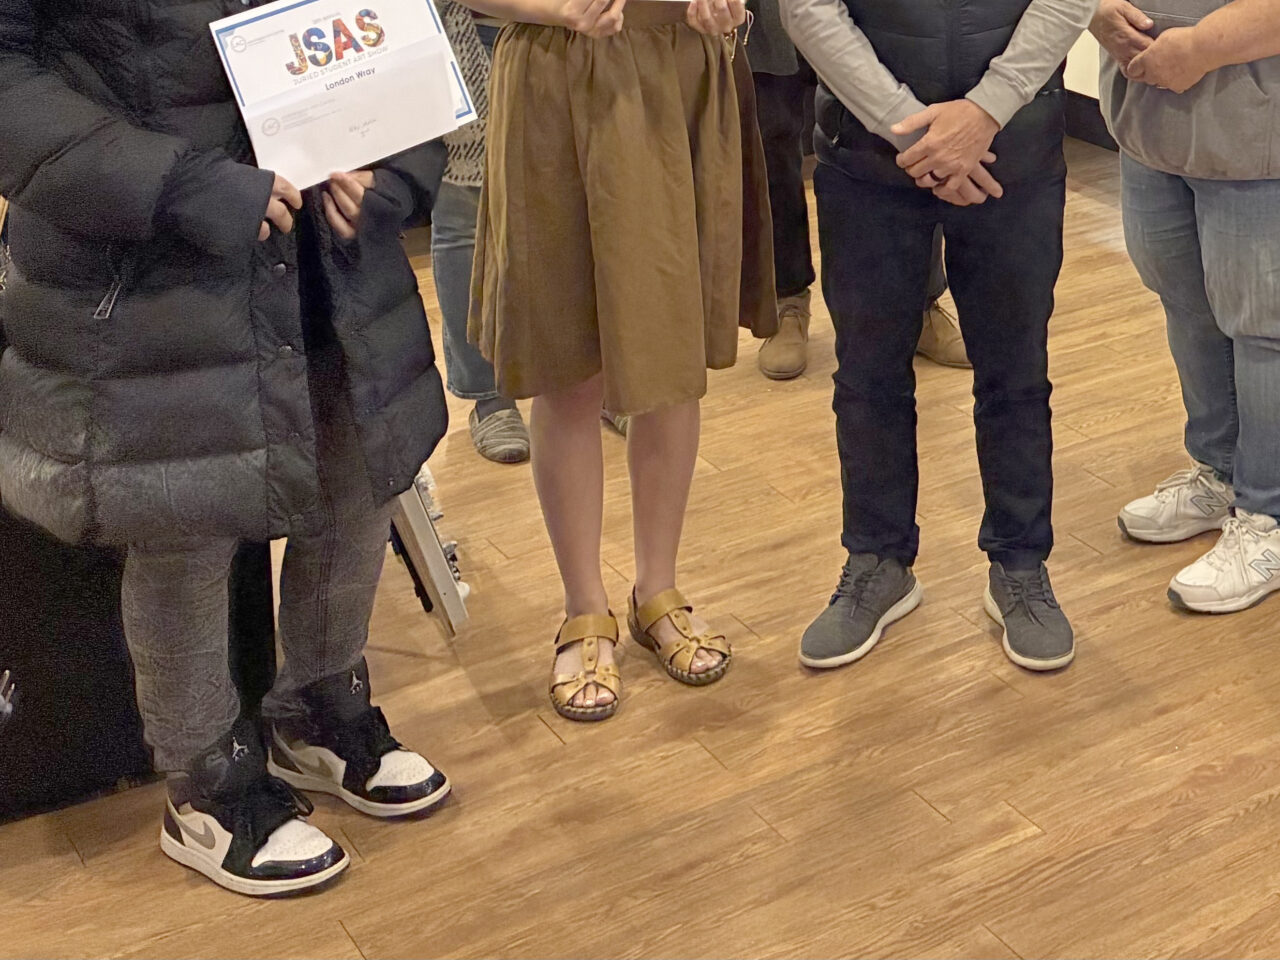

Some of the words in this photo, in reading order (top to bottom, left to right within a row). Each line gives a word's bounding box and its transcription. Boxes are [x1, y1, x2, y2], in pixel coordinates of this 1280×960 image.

[285, 8, 385, 75] JSAS
[294, 71, 319, 85] JURIED
[320, 58, 351, 76] STUDENT
[325, 75, 354, 90] London
[355, 67, 376, 80] Wray
